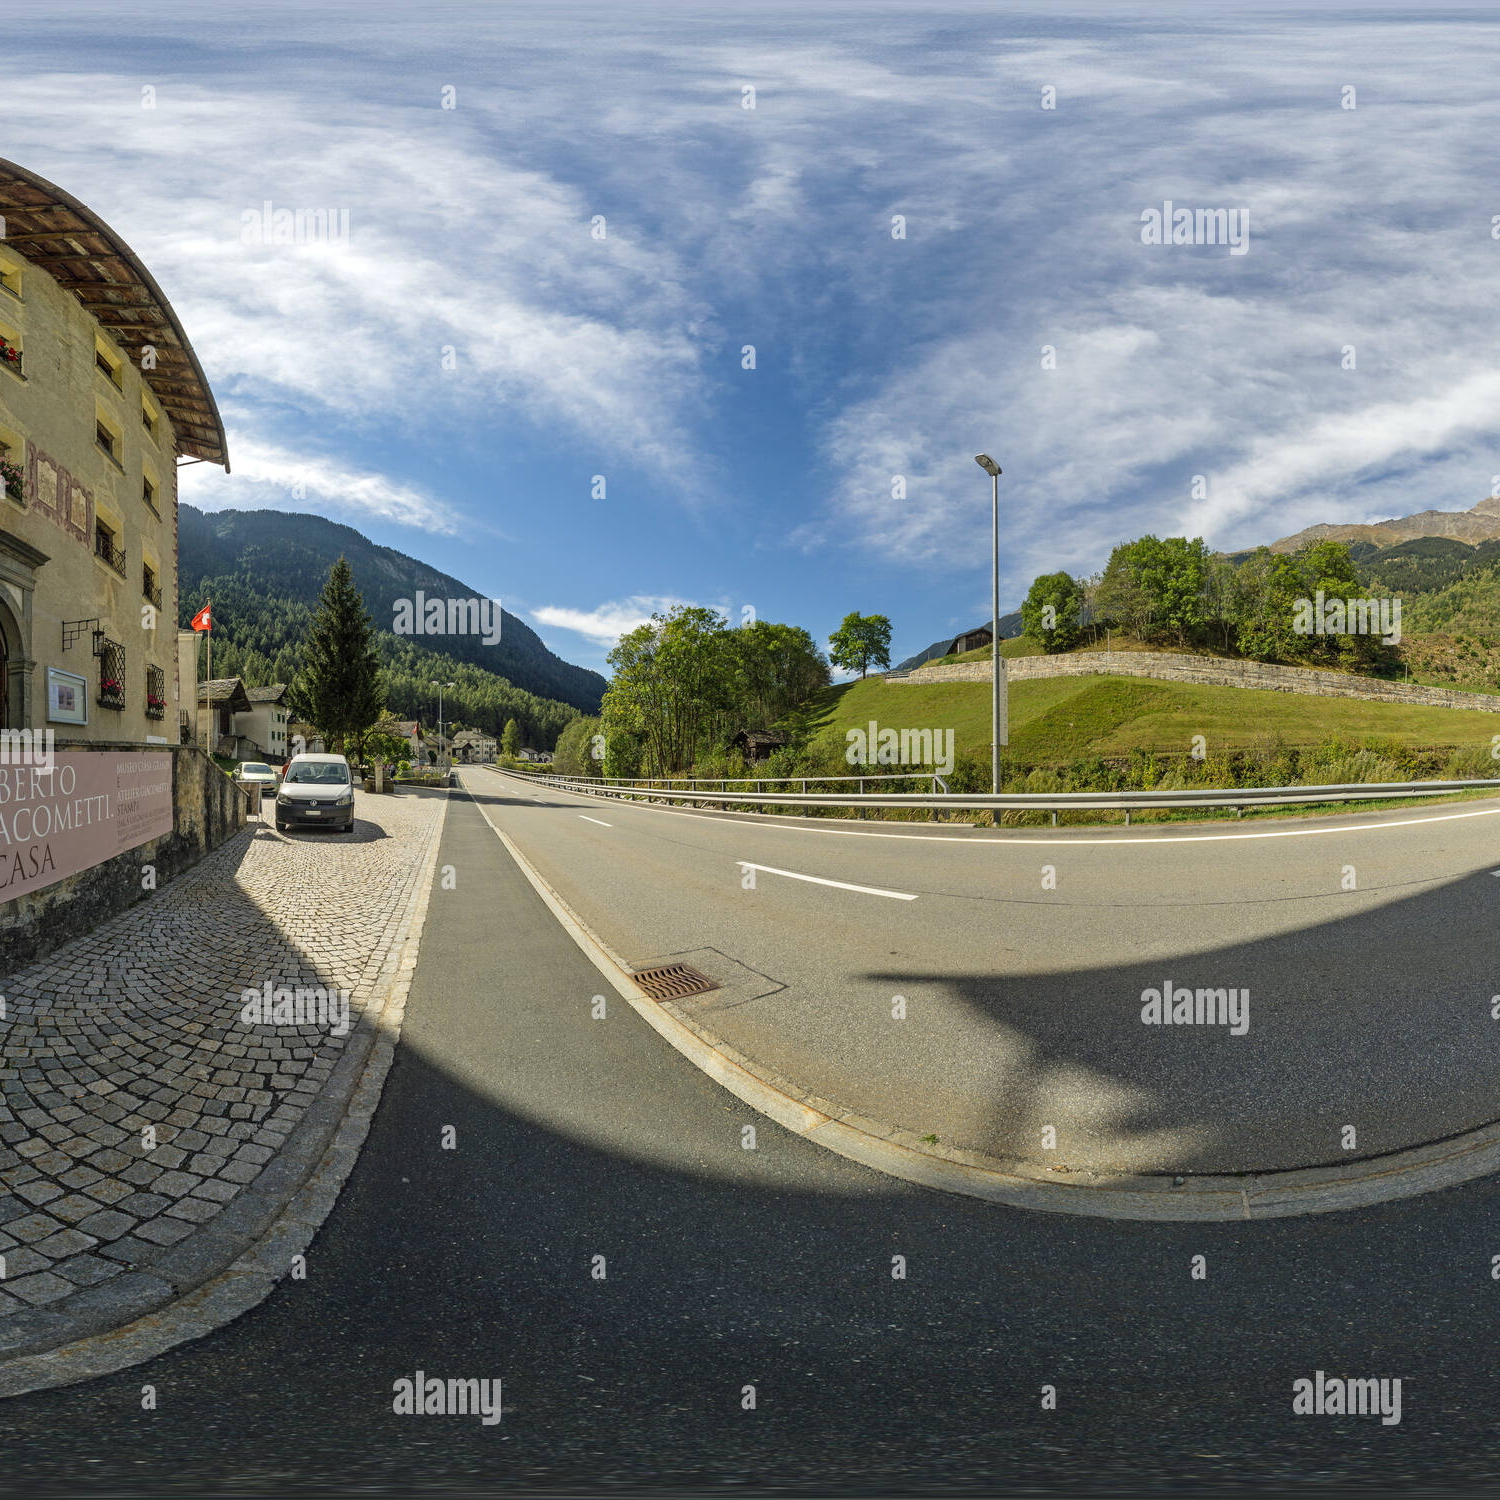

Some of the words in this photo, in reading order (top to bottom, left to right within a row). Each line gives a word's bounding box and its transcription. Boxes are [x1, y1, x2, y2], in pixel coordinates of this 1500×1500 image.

[116, 761, 138, 774] MUSEO
[116, 787, 140, 802] ATELIER
[117, 801, 139, 817] STAMPA
